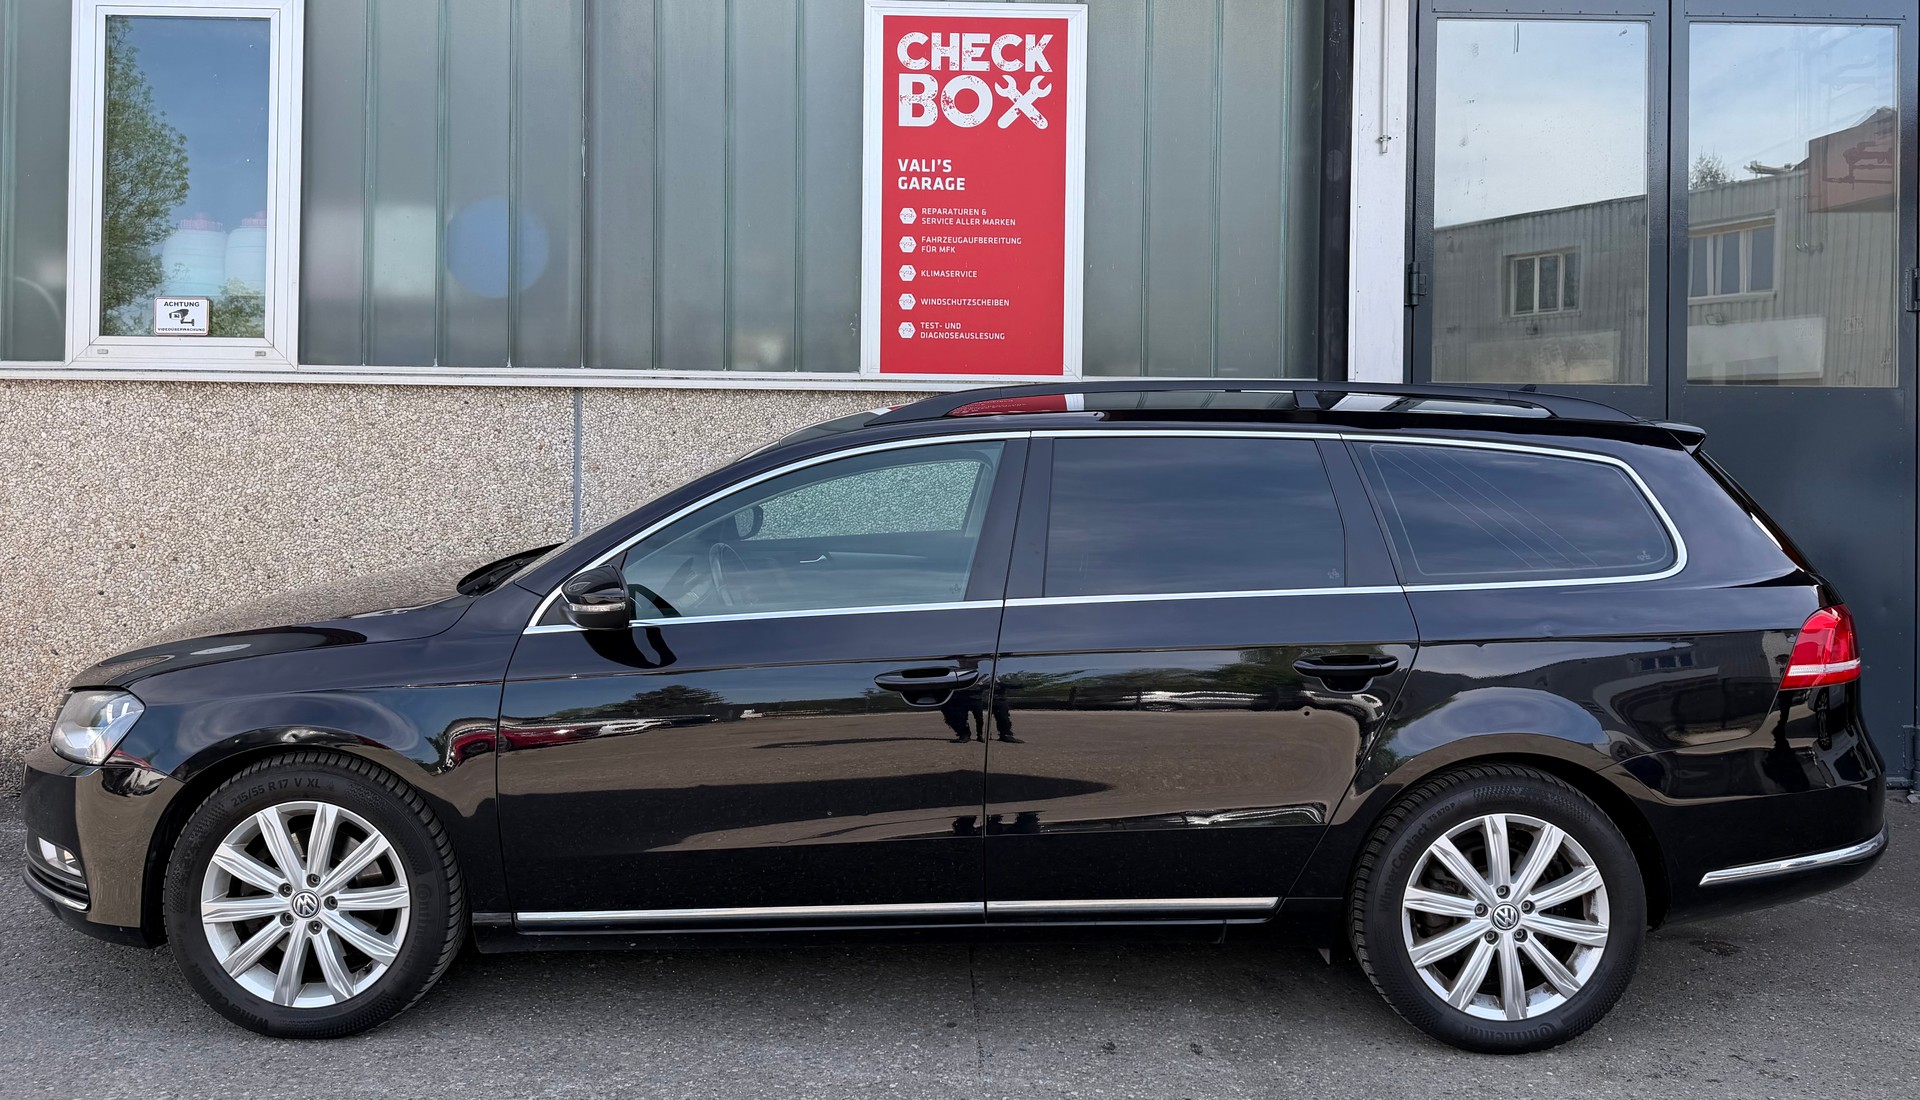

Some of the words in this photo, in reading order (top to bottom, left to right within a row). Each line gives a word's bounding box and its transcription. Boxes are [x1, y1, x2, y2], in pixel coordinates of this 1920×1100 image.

[897, 32, 1053, 72] CHECK
[898, 73, 1052, 130] BOX
[898, 158, 952, 173] VALI'S
[898, 176, 965, 191] GARAGE
[921, 208, 979, 216] REPARATUREN
[981, 208, 987, 216] &
[921, 217, 953, 225] SERVICE
[956, 218, 980, 226] ALLER
[982, 218, 1016, 226] MARKEN
[921, 236, 1022, 245] FAHRZEUGAUFBEREITUNG
[921, 245, 937, 253] FÜR
[920, 270, 977, 278] KLIMASERVICE
[920, 298, 1010, 307] WINDSCHUTZSCHEIBEN
[920, 322, 942, 330] TEST-
[945, 322, 961, 330] UND
[920, 331, 1005, 340] DIAGNOSEAUSLESUNG
[231, 784, 265, 806] 215/55
[268, 781, 277, 792] R
[278, 779, 288, 789] 17
[294, 778, 302, 787] V
[306, 778, 321, 789] XL
[1378, 822, 1430, 913] WinterContact
[1427, 812, 1438, 822] TS
